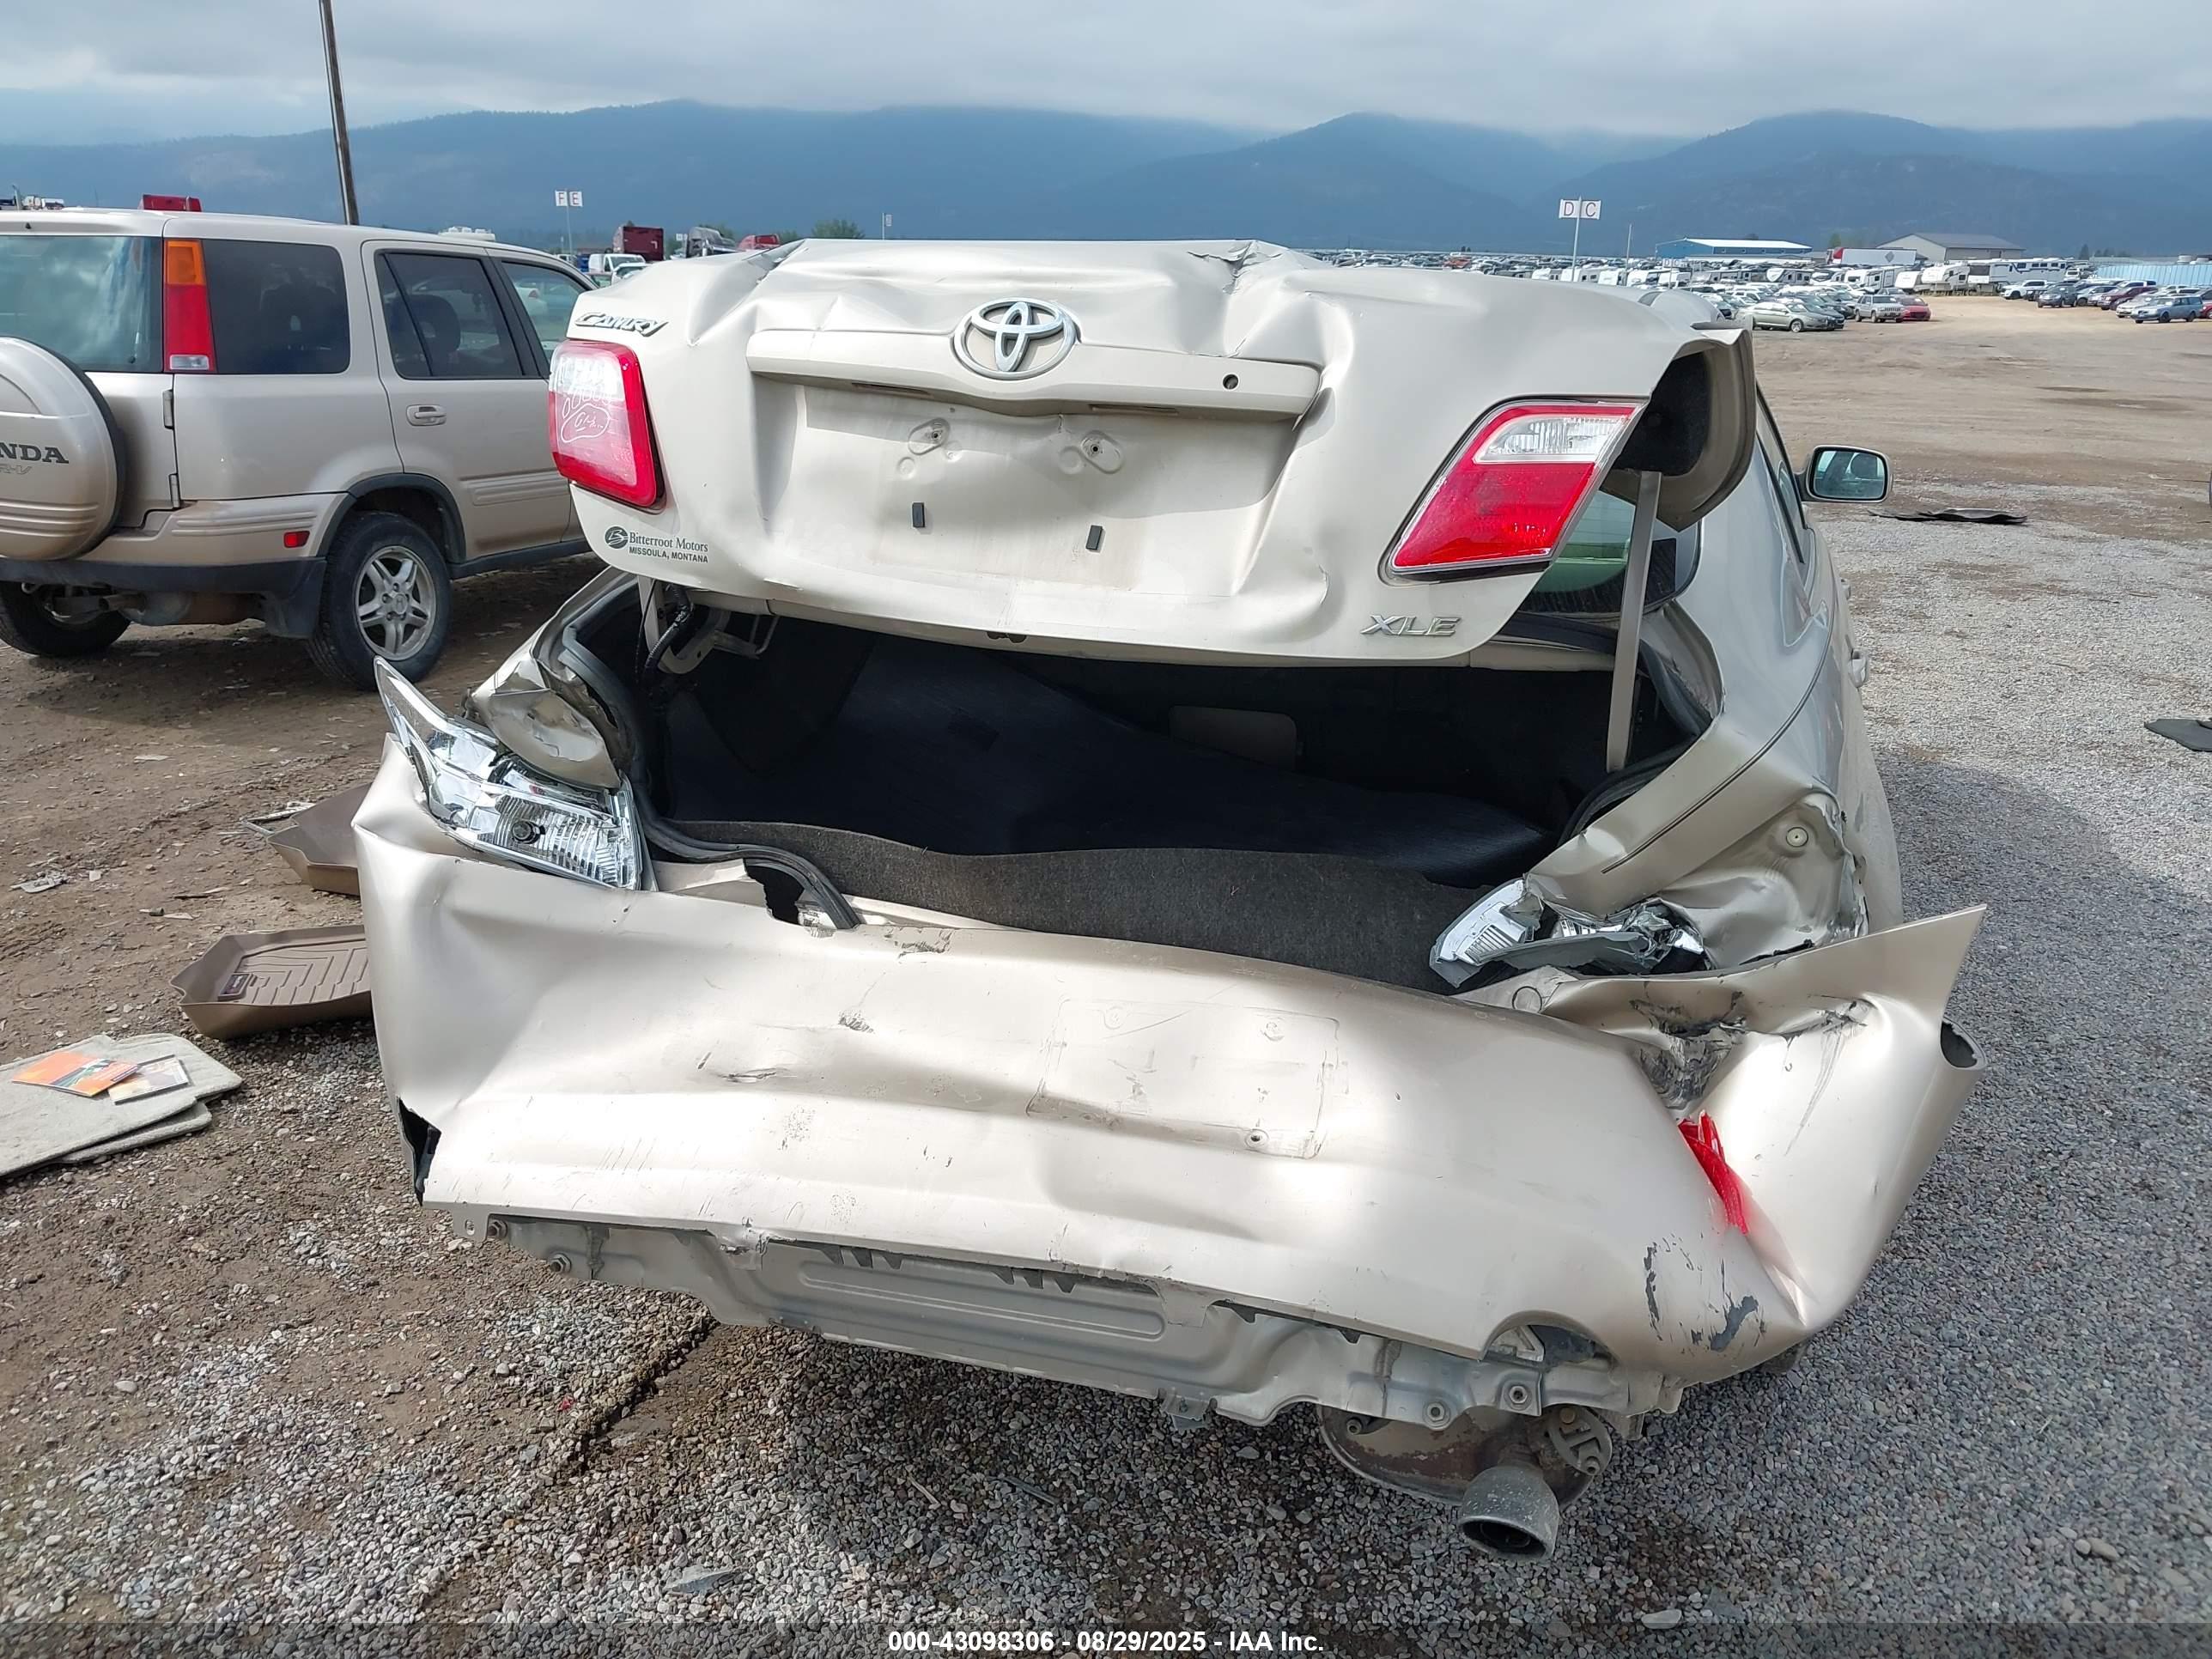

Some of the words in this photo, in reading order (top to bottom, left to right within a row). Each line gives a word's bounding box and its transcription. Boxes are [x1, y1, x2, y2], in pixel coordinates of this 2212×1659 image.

[558, 191, 564, 205] F
[570, 191, 580, 205] E
[1563, 201, 1575, 216] D
[1585, 202, 1596, 217] C
[629, 532, 673, 549] Bitterroot
[676, 537, 708, 552] Motors
[629, 546, 670, 560] MISSOULA,
[671, 551, 708, 563] MONTANA
[1359, 614, 1462, 637] XLE
